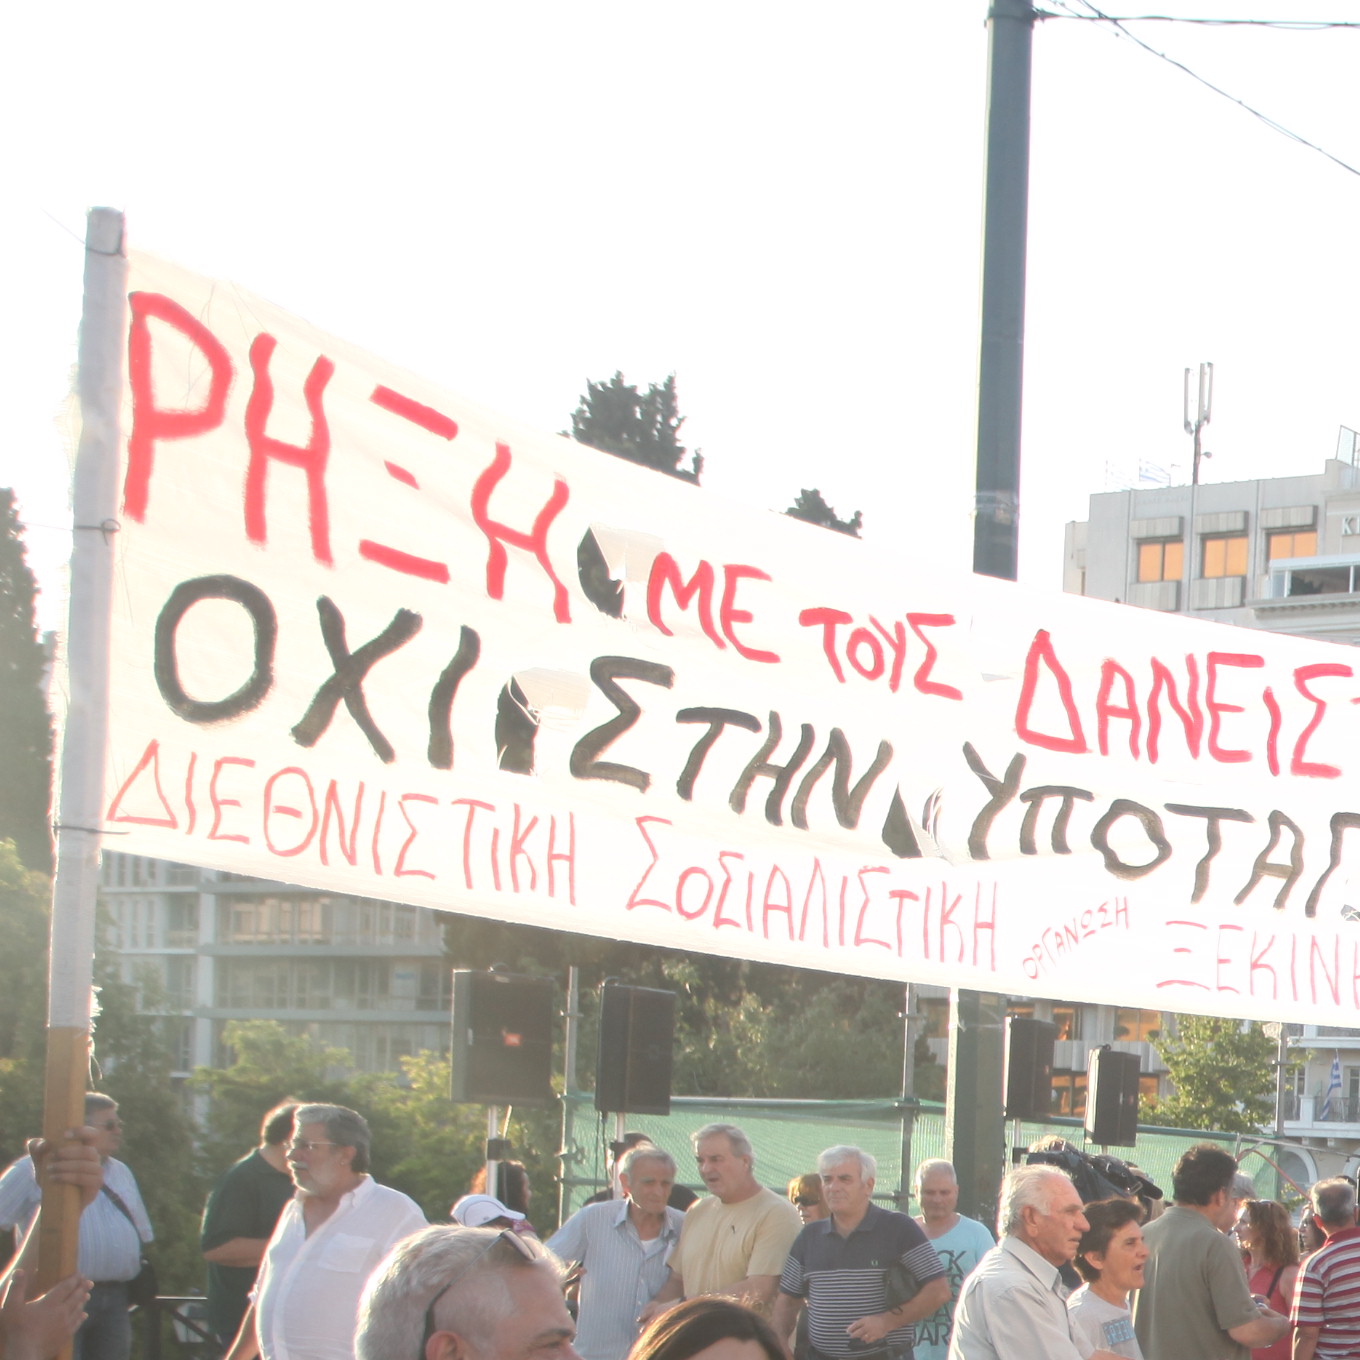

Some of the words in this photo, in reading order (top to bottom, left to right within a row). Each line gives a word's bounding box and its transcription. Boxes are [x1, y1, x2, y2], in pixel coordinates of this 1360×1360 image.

[122, 290, 571, 624] ΡΗΞΗ
[646, 551, 782, 664] ΜΕ
[798, 607, 964, 701] ΤΟΥΣ
[153, 573, 482, 771] ΟΧΙ
[569, 655, 894, 831] ΣΤΗΝ
[105, 738, 577, 908] ΔΙΕΘΝΙΣΤΙΚΗ
[625, 814, 997, 972] ΣΟΣΙΑΛΙΣΤΙΚΗ
[1022, 895, 1130, 980] ΟΡΓΑΝΩΣΗ
